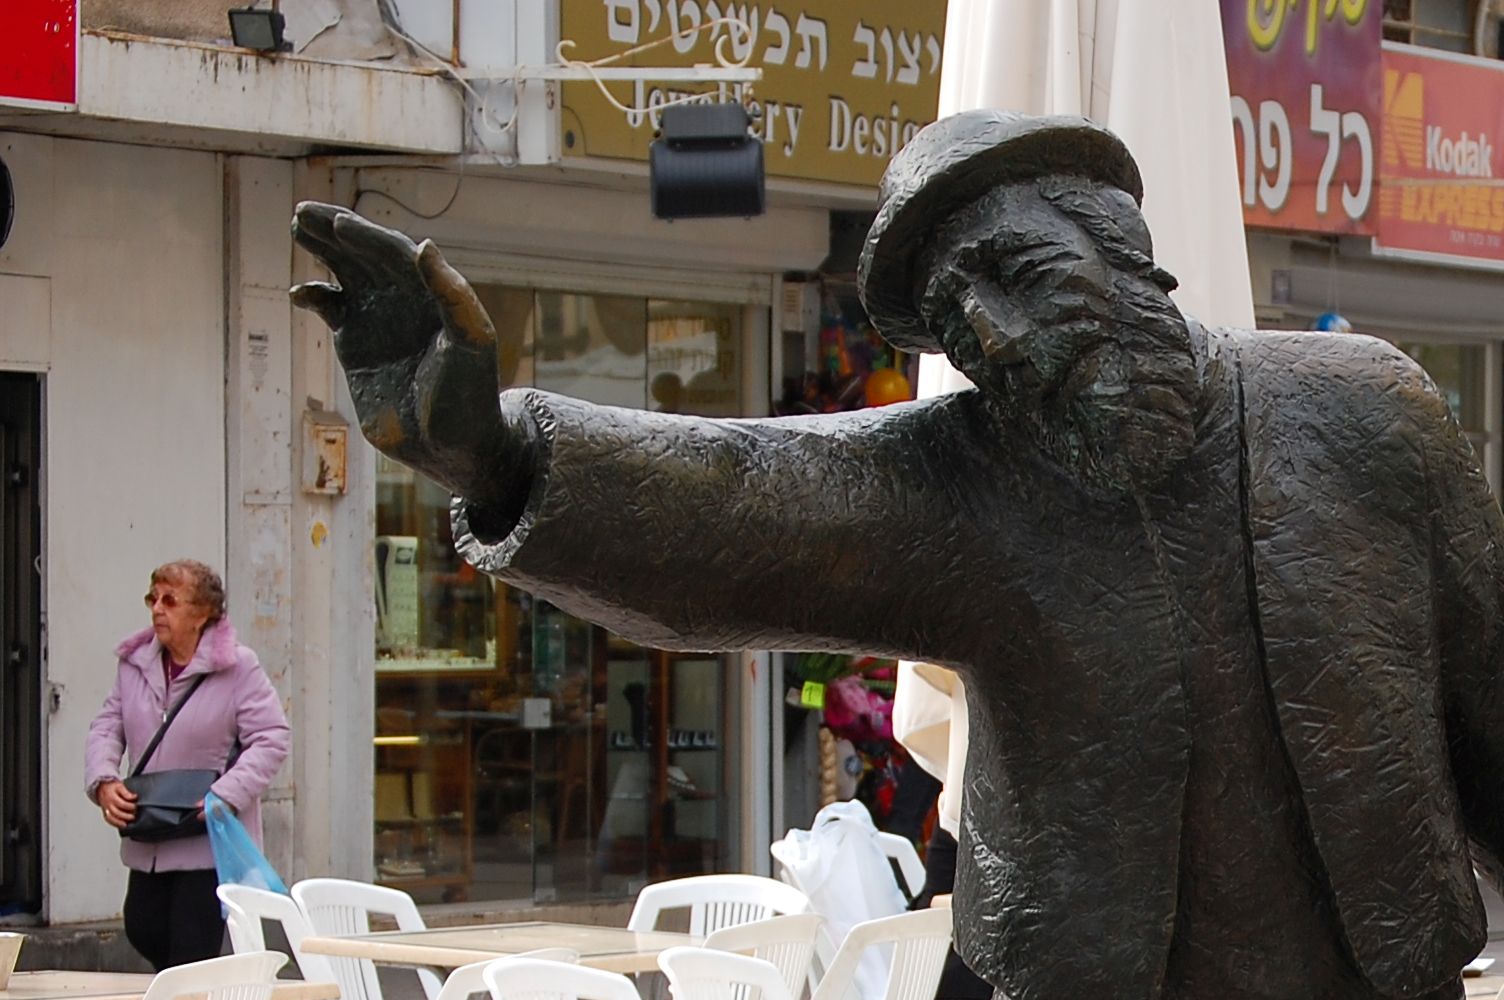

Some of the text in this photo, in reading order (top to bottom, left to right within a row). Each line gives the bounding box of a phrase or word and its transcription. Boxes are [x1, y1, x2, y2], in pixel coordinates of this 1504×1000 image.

[604, 0, 940, 85] יצוב תכשיטים
[627, 77, 925, 157] Jeery Desi
[1310, 83, 1373, 219] כל
[1426, 124, 1492, 178] Kodak
